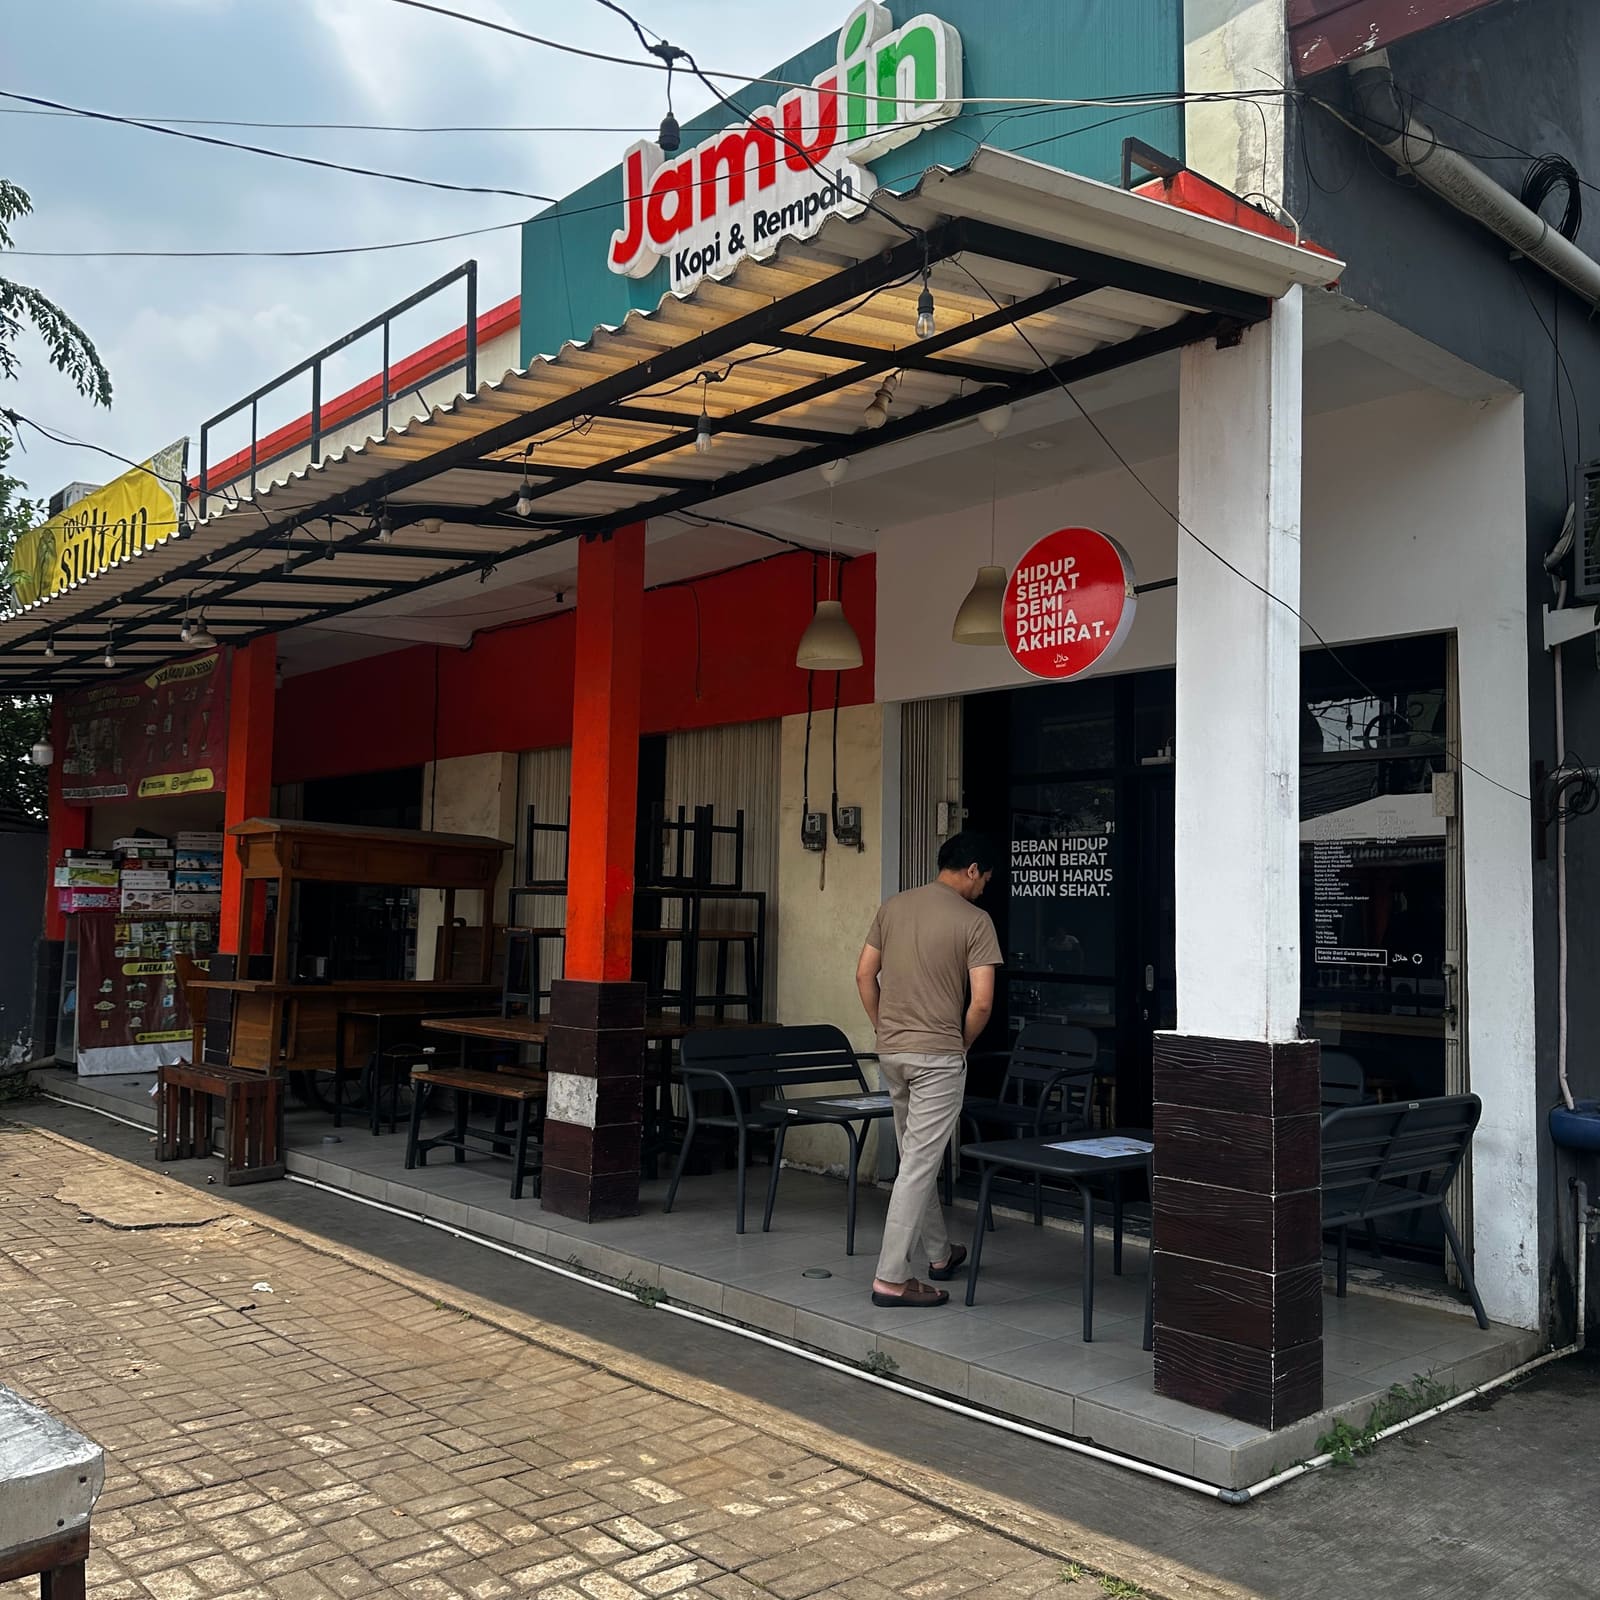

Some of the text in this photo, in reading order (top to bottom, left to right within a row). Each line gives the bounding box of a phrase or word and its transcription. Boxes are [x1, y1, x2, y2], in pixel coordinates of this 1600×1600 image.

[613, 12, 938, 265] Jamuin
[675, 168, 853, 282] Kopi & Rempah
[1016, 557, 1076, 585] HIDUP
[1016, 573, 1080, 602] SEHAT
[1016, 595, 1063, 619] DEMI
[1016, 610, 1078, 636] DUNIA
[1016, 621, 1111, 653] AKHIRAT.
[1011, 837, 1109, 853] BEBAN HIDUP
[1011, 852, 1108, 867] MAKIN BERAT
[1011, 868, 1113, 883] TUBUH HARUS
[1011, 883, 1111, 897] MAKIN SEHAT.
